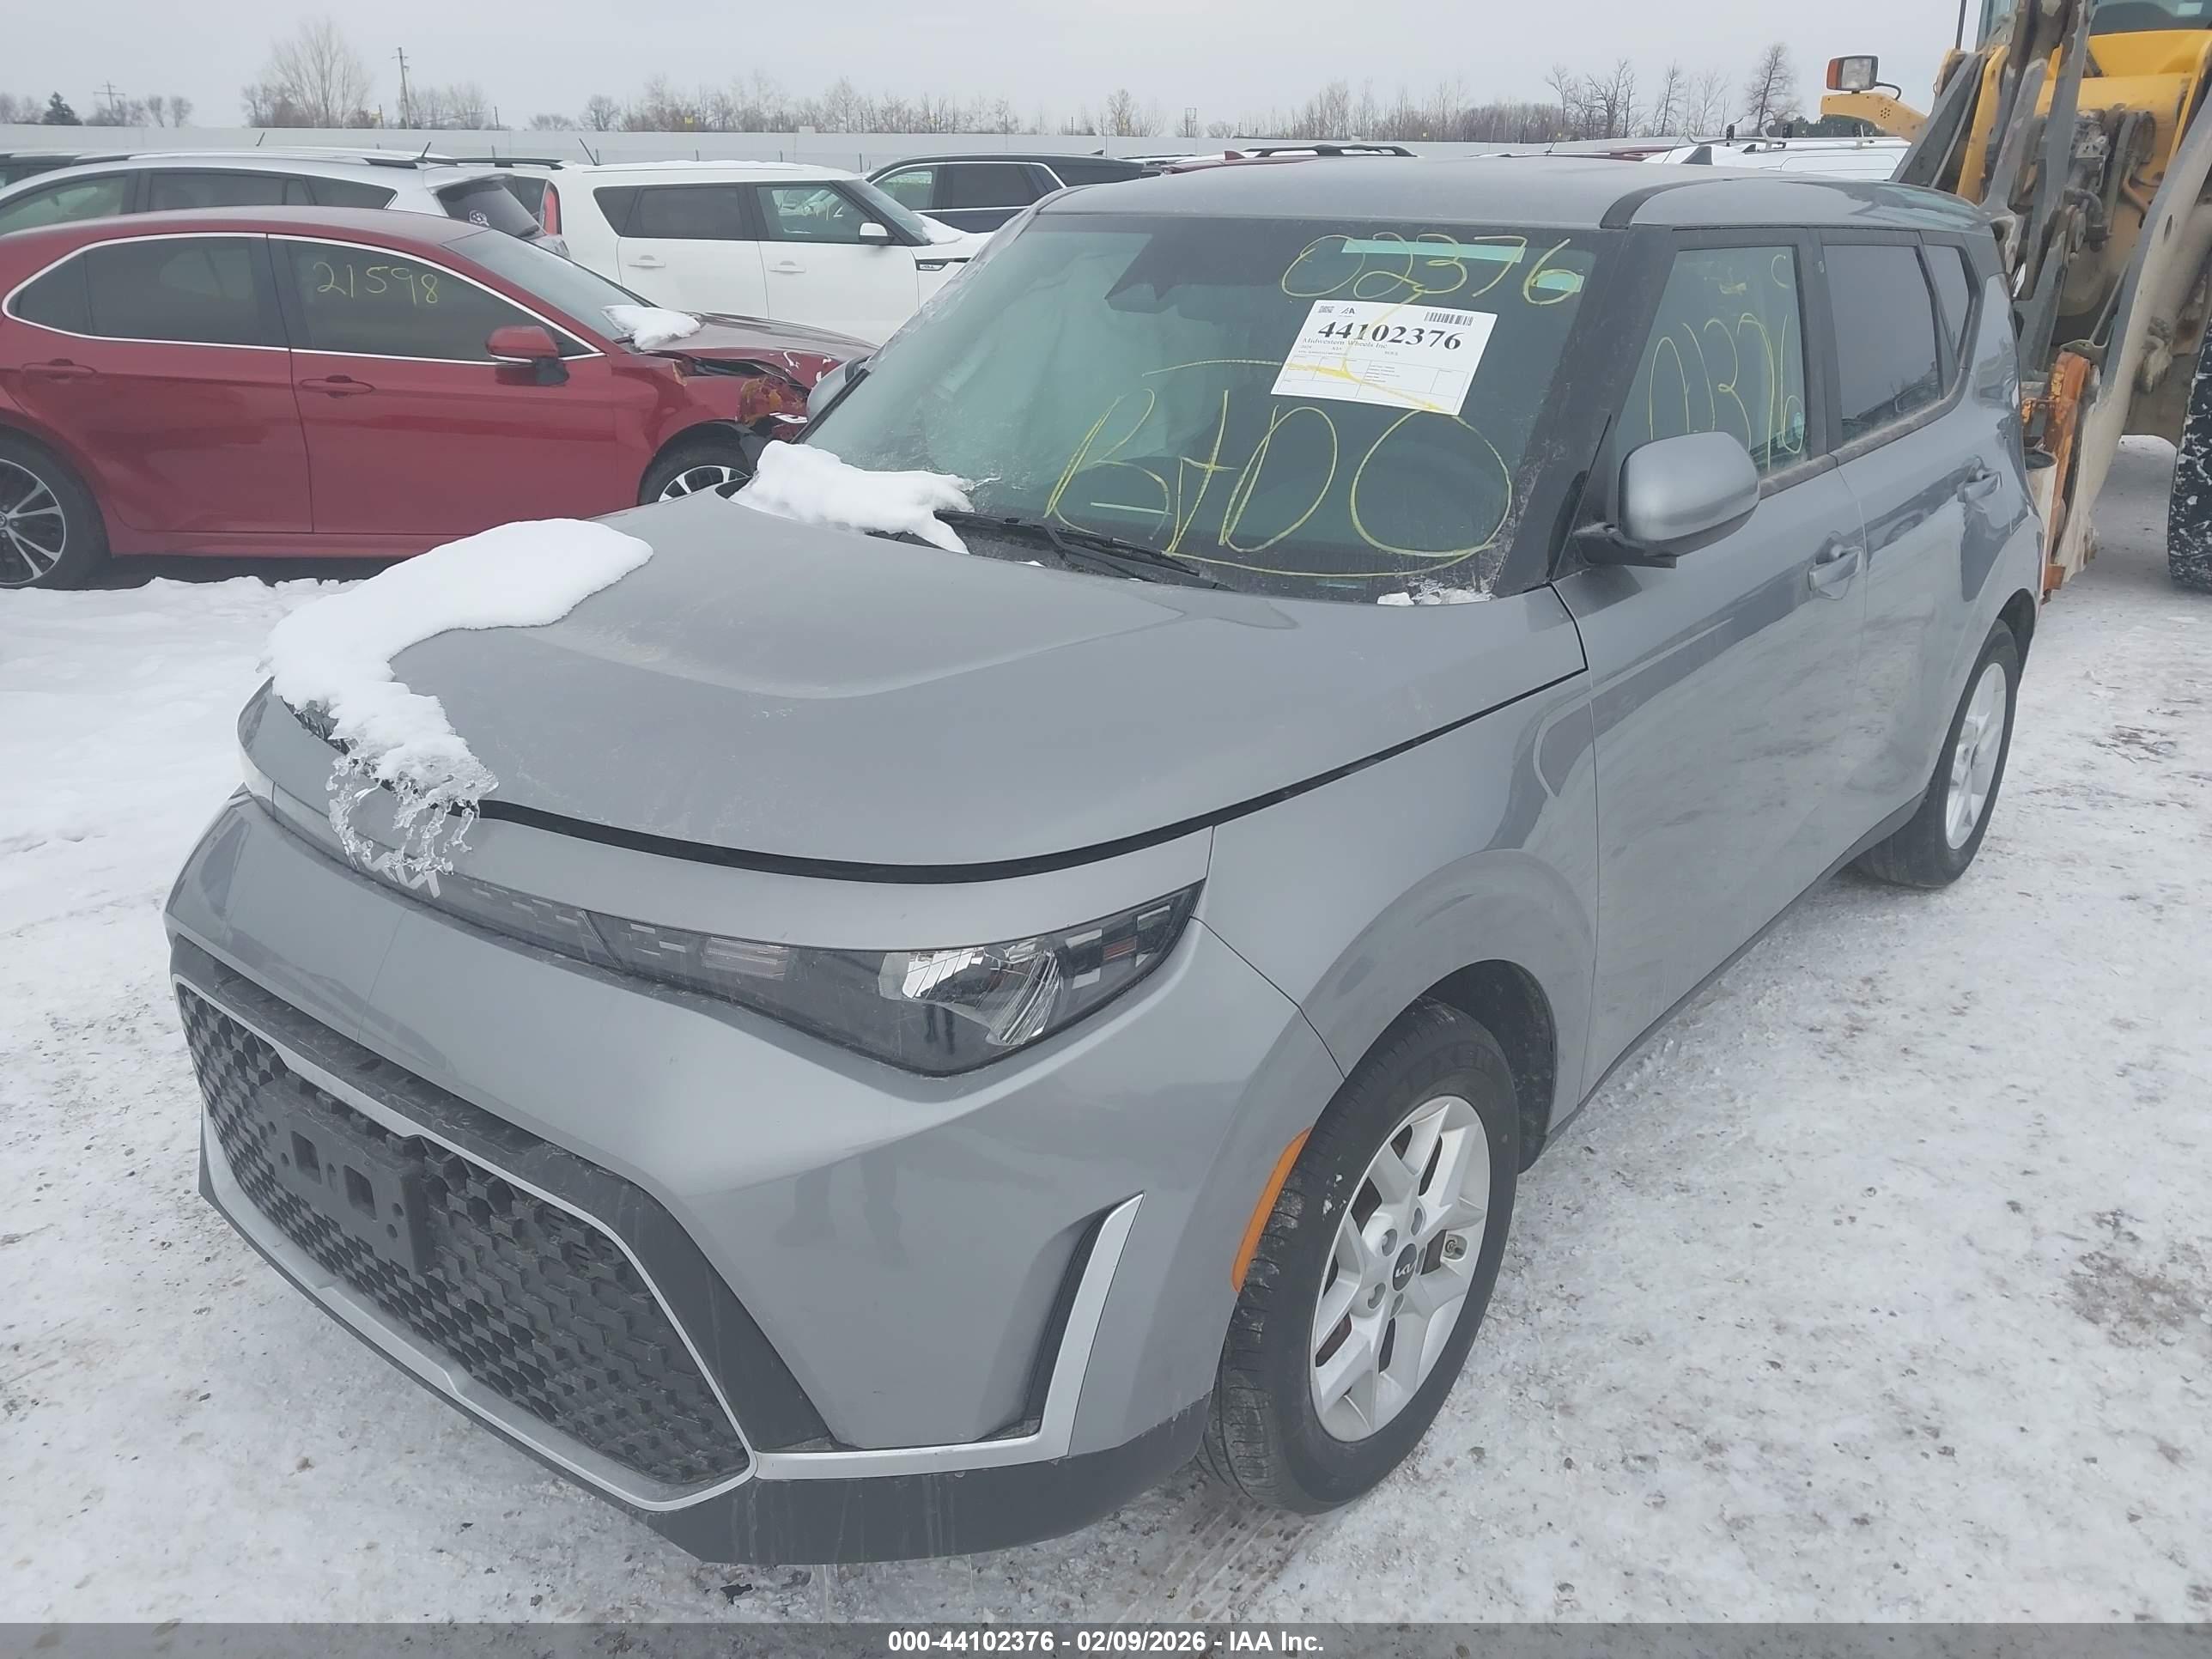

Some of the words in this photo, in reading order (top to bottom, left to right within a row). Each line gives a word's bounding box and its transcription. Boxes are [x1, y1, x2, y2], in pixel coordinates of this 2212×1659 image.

[313, 261, 438, 305] 21598
[1281, 231, 1581, 306] 02376
[1317, 320, 1465, 350] 44102376
